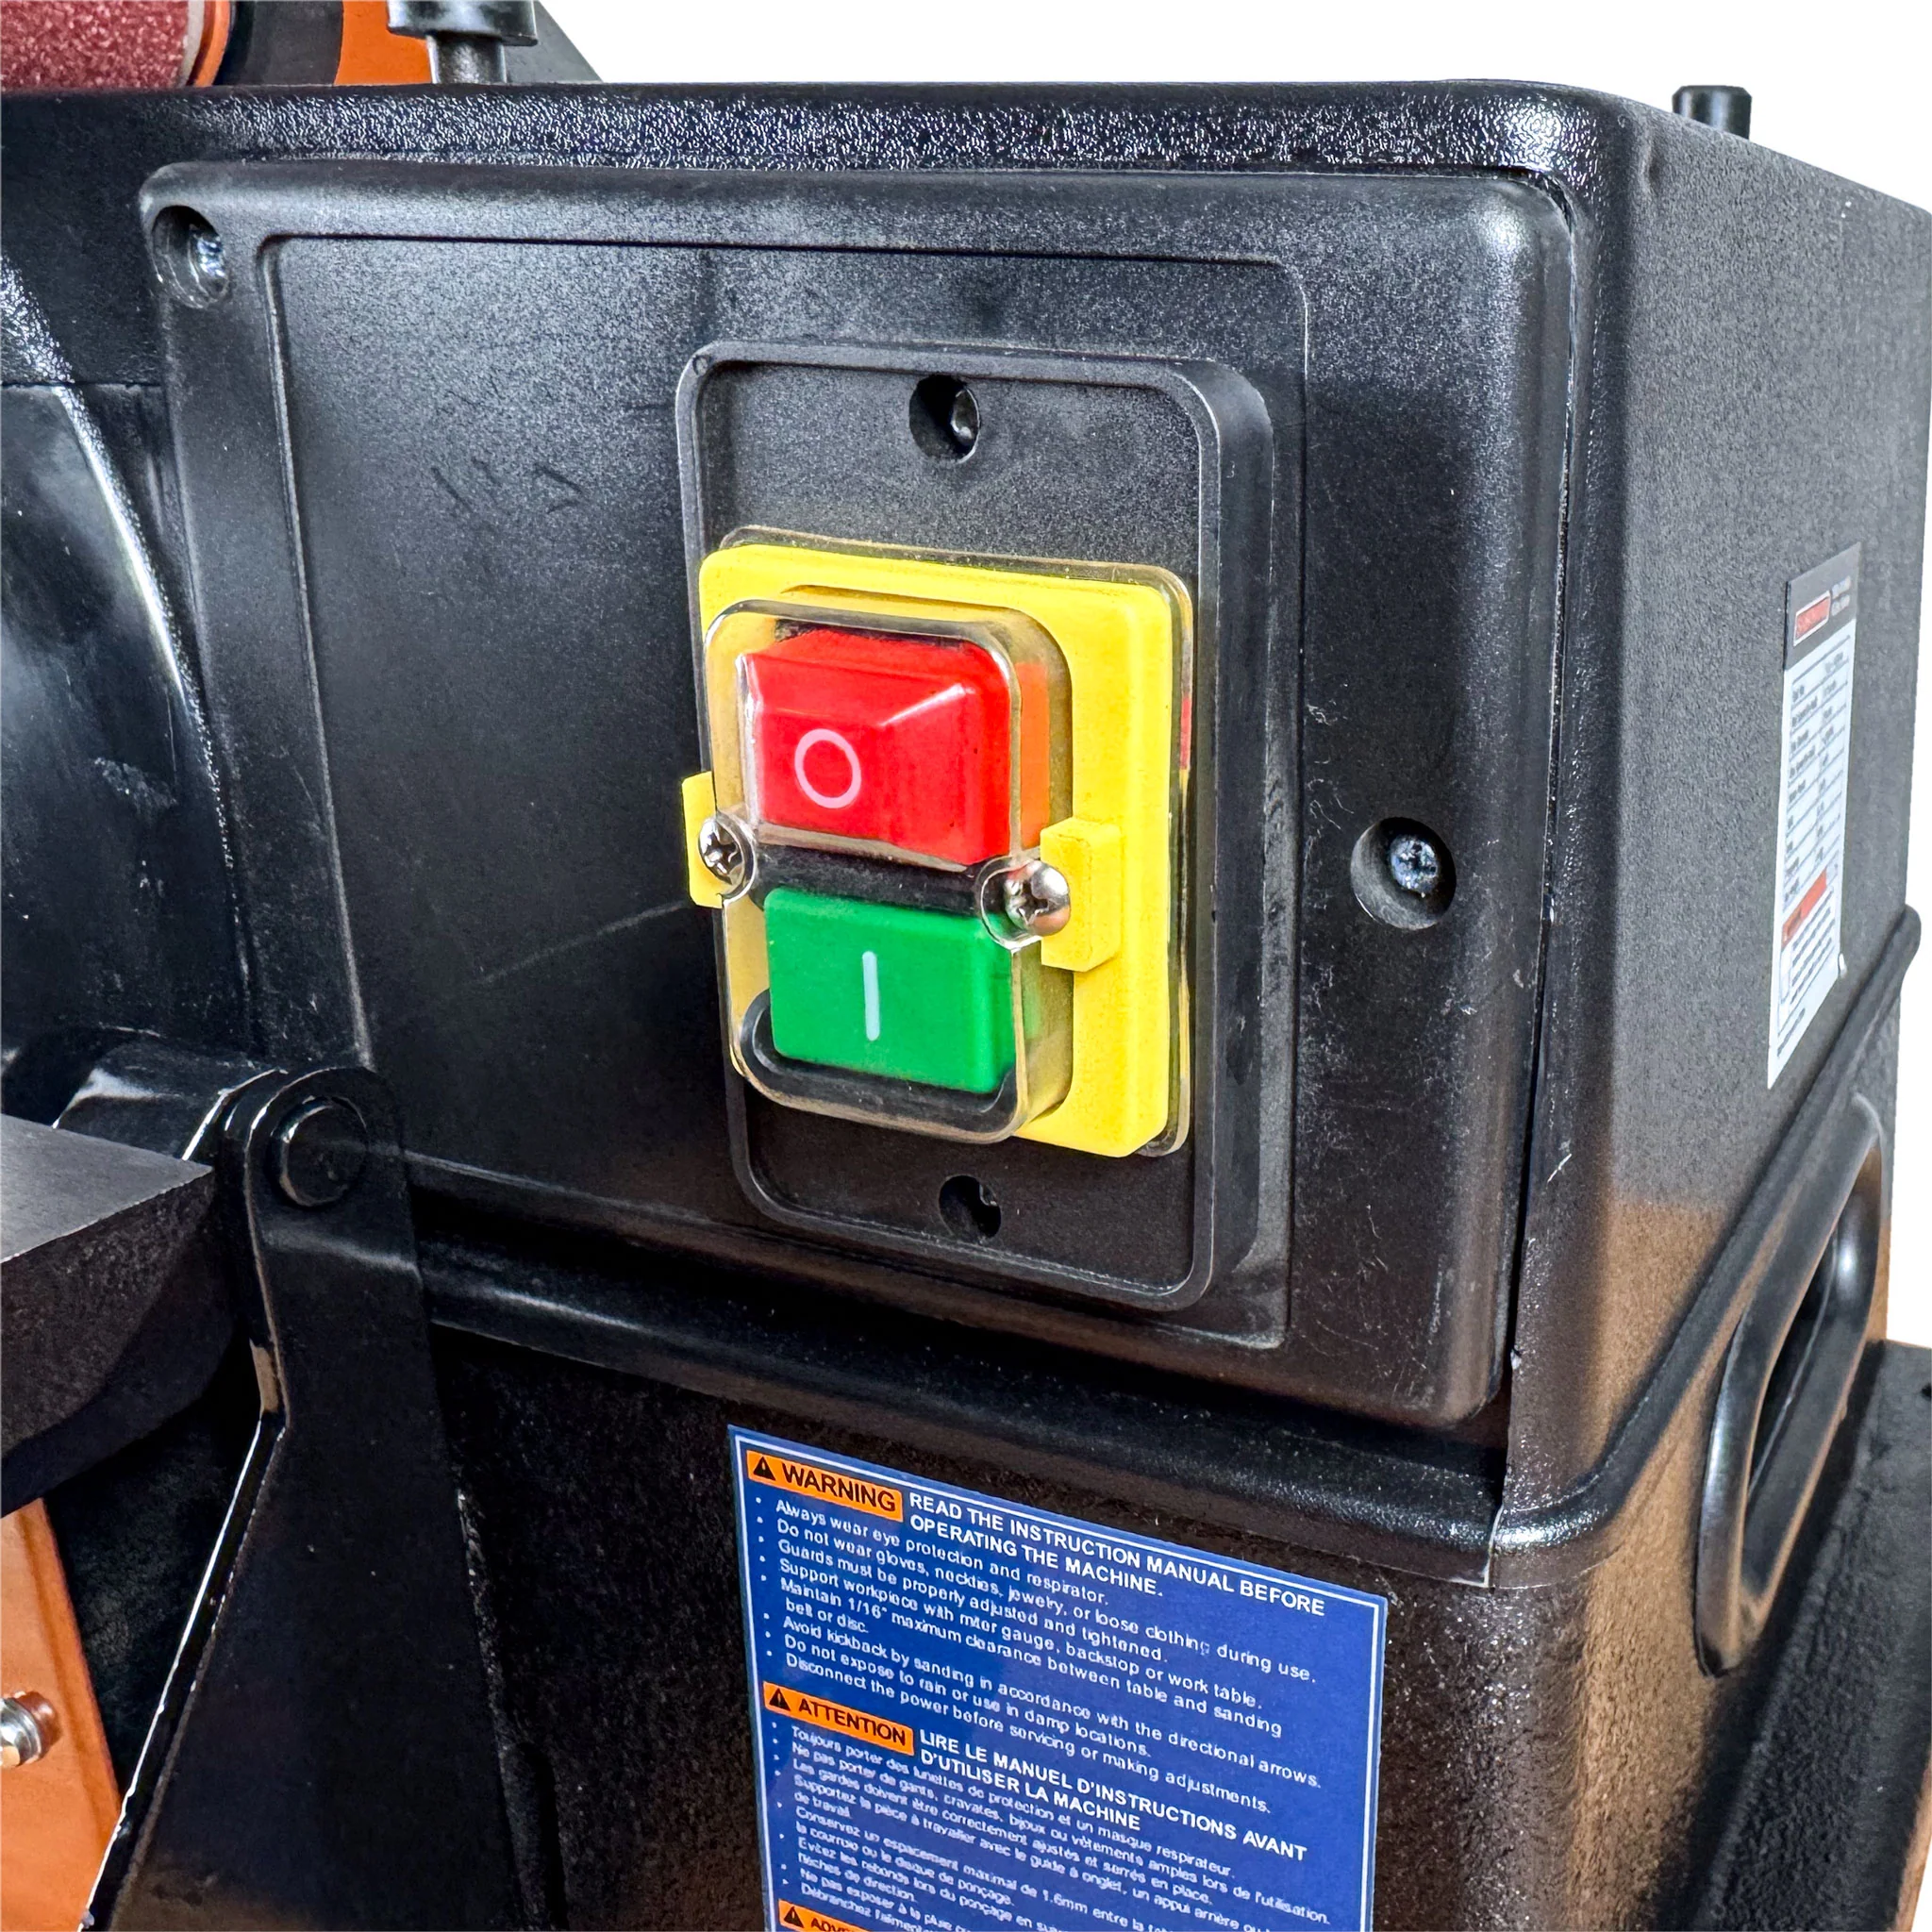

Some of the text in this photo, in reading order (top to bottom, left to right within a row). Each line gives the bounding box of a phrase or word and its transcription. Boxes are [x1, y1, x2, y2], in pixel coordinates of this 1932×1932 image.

[782, 1462, 896, 1512] WARNING
[774, 1499, 1108, 1605] Always wear eye protection and respirator.
[776, 1517, 799, 1537] Do
[803, 1528, 829, 1546] not
[832, 1537, 872, 1557] wear
[875, 1549, 929, 1577] gloves,
[1073, 1606, 1091, 1620] or
[1094, 1607, 1139, 1634] loose
[1144, 1624, 1209, 1656] clothing
[1216, 1643, 1272, 1674] during
[1277, 1662, 1315, 1683] use.
[777, 1538, 1167, 1662] Guards must be properly adjusted and tightened.
[785, 1596, 813, 1618] belt
[816, 1609, 833, 1623] or
[908, 1491, 1324, 1616] READ THE INSTRUCTION MANUAL BEFORE
[909, 1513, 1162, 1596] OPERATING THE MACHINE.
[778, 1557, 1261, 1708] Support workpiece with miter gauge, backstop or work table.
[779, 1576, 841, 1607] Maintain
[891, 1611, 961, 1643] maximum
[964, 1633, 1041, 1666] clearance
[1046, 1655, 1120, 1689] between
[1125, 1679, 1167, 1703] table
[1173, 1694, 1207, 1714] and
[1213, 1706, 1281, 1738] sanding
[783, 1633, 806, 1652] Do
[810, 1643, 836, 1661] not
[840, 1653, 894, 1679] expose
[898, 1669, 914, 1686] to
[919, 1677, 946, 1696] rain
[951, 1688, 969, 1702] or
[972, 1694, 1000, 1712] use
[1006, 1701, 1019, 1718] in
[1024, 1708, 1070, 1734] damp
[782, 1615, 1321, 1788] Avoid kickback by sanding in accordance with the directional arrows.
[785, 1652, 1271, 1813] Disconnect the power before servicing or making adjustments.
[798, 1698, 906, 1746] ATTENTION
[919, 1728, 1307, 1861] LIRE LE MANUEL D'INSTRUCTIONS AVANT
[920, 1748, 1141, 1831] D'UTILISER LA MACHINE
